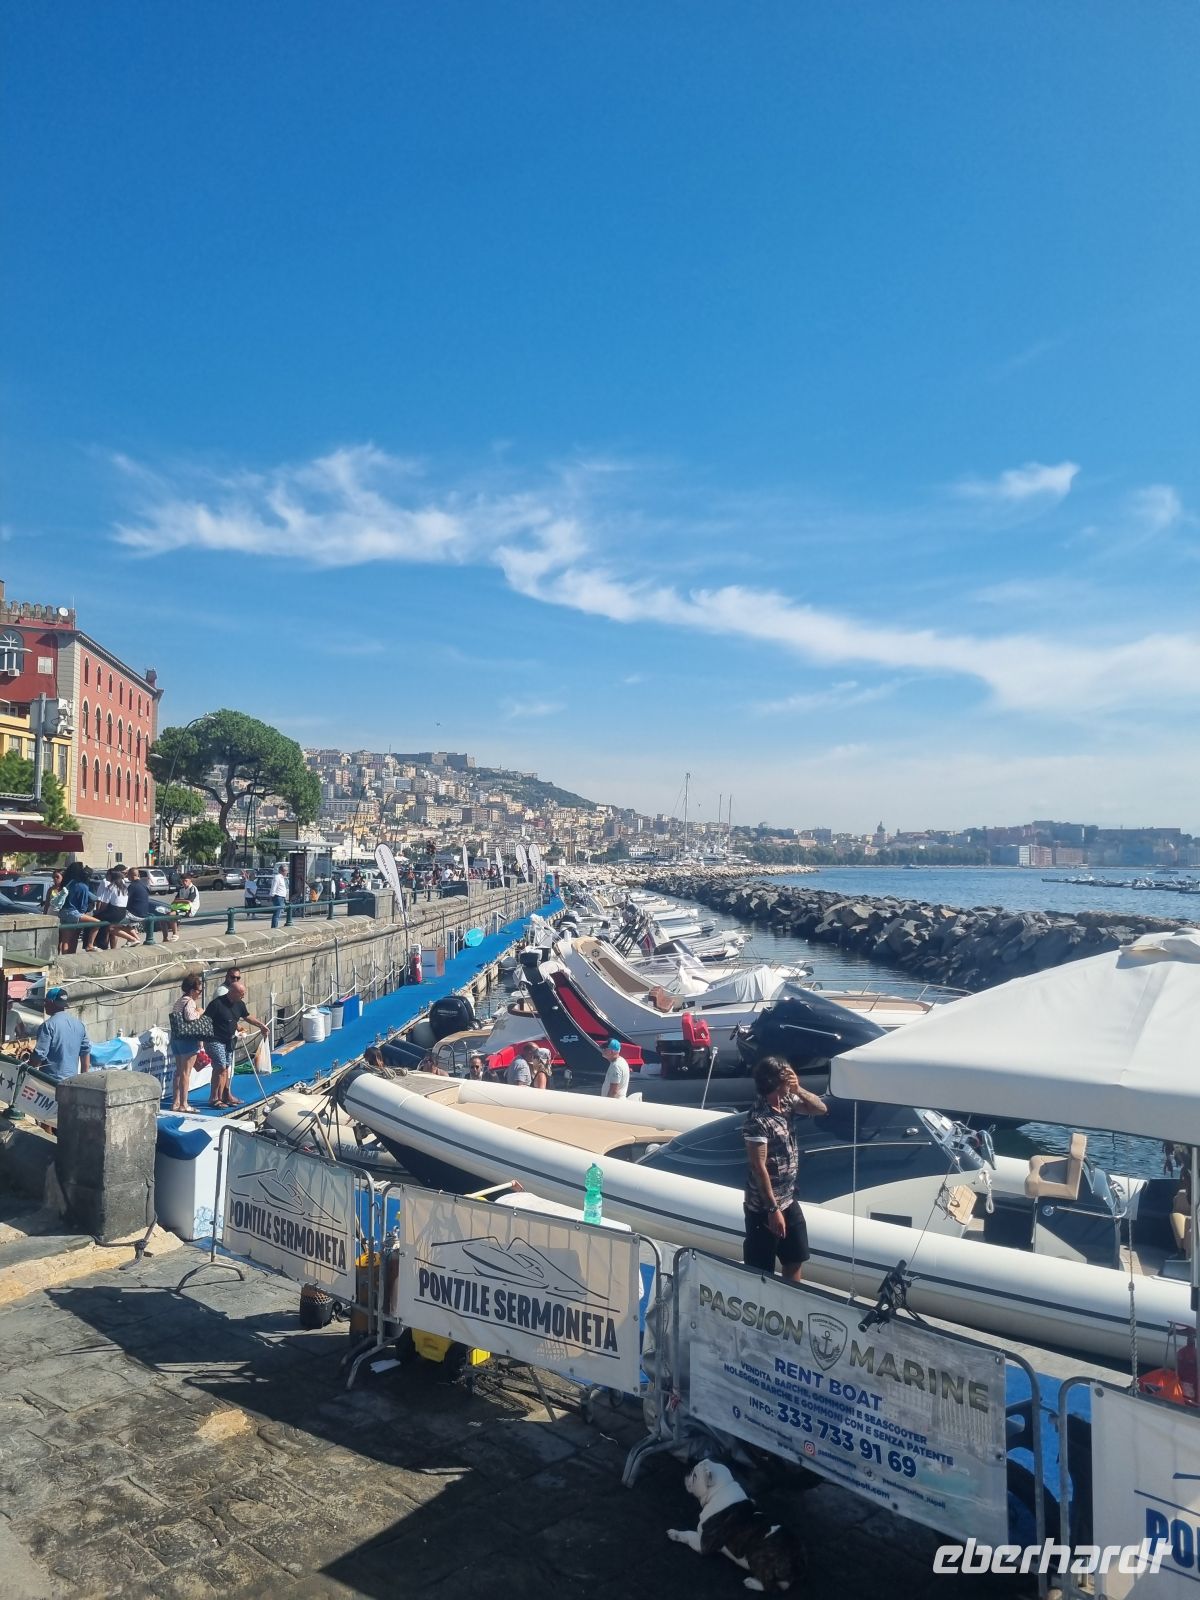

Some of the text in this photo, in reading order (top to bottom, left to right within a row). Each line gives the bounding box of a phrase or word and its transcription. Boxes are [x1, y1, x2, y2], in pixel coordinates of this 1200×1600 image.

[34, 1092, 55, 1110] TIM
[229, 1198, 346, 1270] PONTILE SERMONETA
[419, 1268, 618, 1352] PONTILE SERMONETA
[699, 1283, 989, 1414] PASSION MARINE
[724, 1363, 954, 1466] NOLEGGIO BARCHE E GOMMONI CON E SENZA PATENTE
[740, 1360, 772, 1382] VENDITA
[812, 1392, 855, 1416] GOMMONI
[856, 1409, 863, 1420] E
[864, 1412, 928, 1445] SEASCOOTER
[775, 1357, 883, 1411] RENT BOAT
[749, 1396, 775, 1417] INFO:
[777, 1401, 813, 1433] 333
[816, 1419, 855, 1452] 733
[860, 1438, 882, 1465] 91
[887, 1450, 917, 1478] 69
[1145, 1507, 1200, 1573] PO
